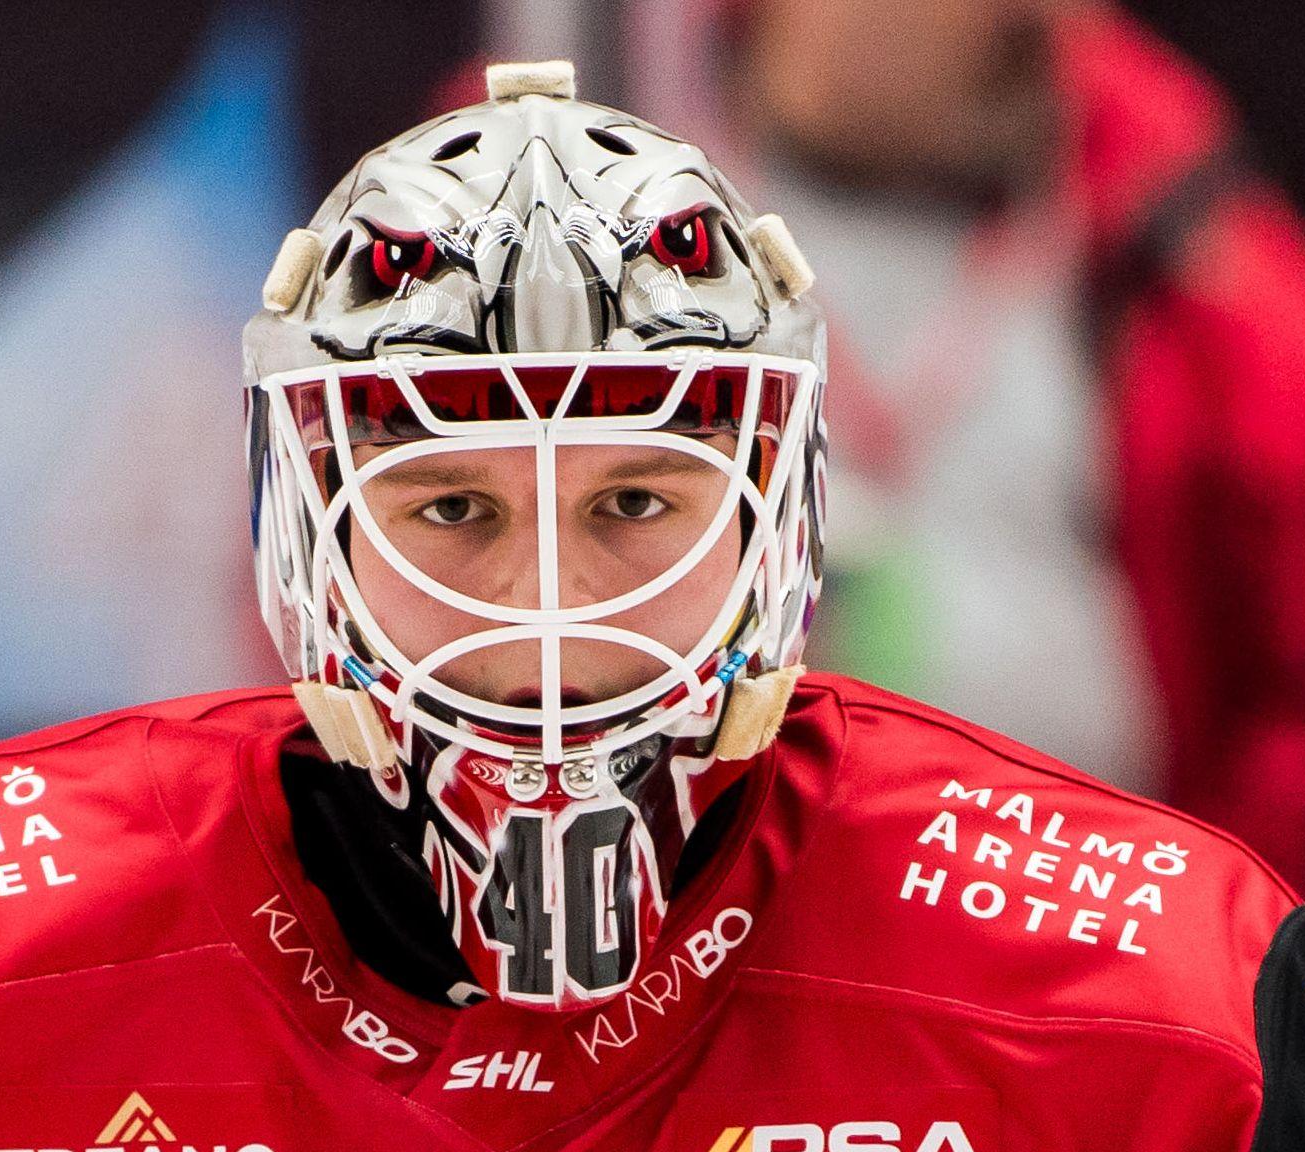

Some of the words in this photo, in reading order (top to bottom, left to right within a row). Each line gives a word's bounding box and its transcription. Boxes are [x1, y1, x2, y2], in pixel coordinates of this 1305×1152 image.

[918, 811, 1163, 914] ARENA
[939, 780, 1189, 876] MALMÖ
[475, 802, 641, 1004] 40
[899, 862, 1147, 956] HOTEL
[443, 1051, 555, 1092] SHL
